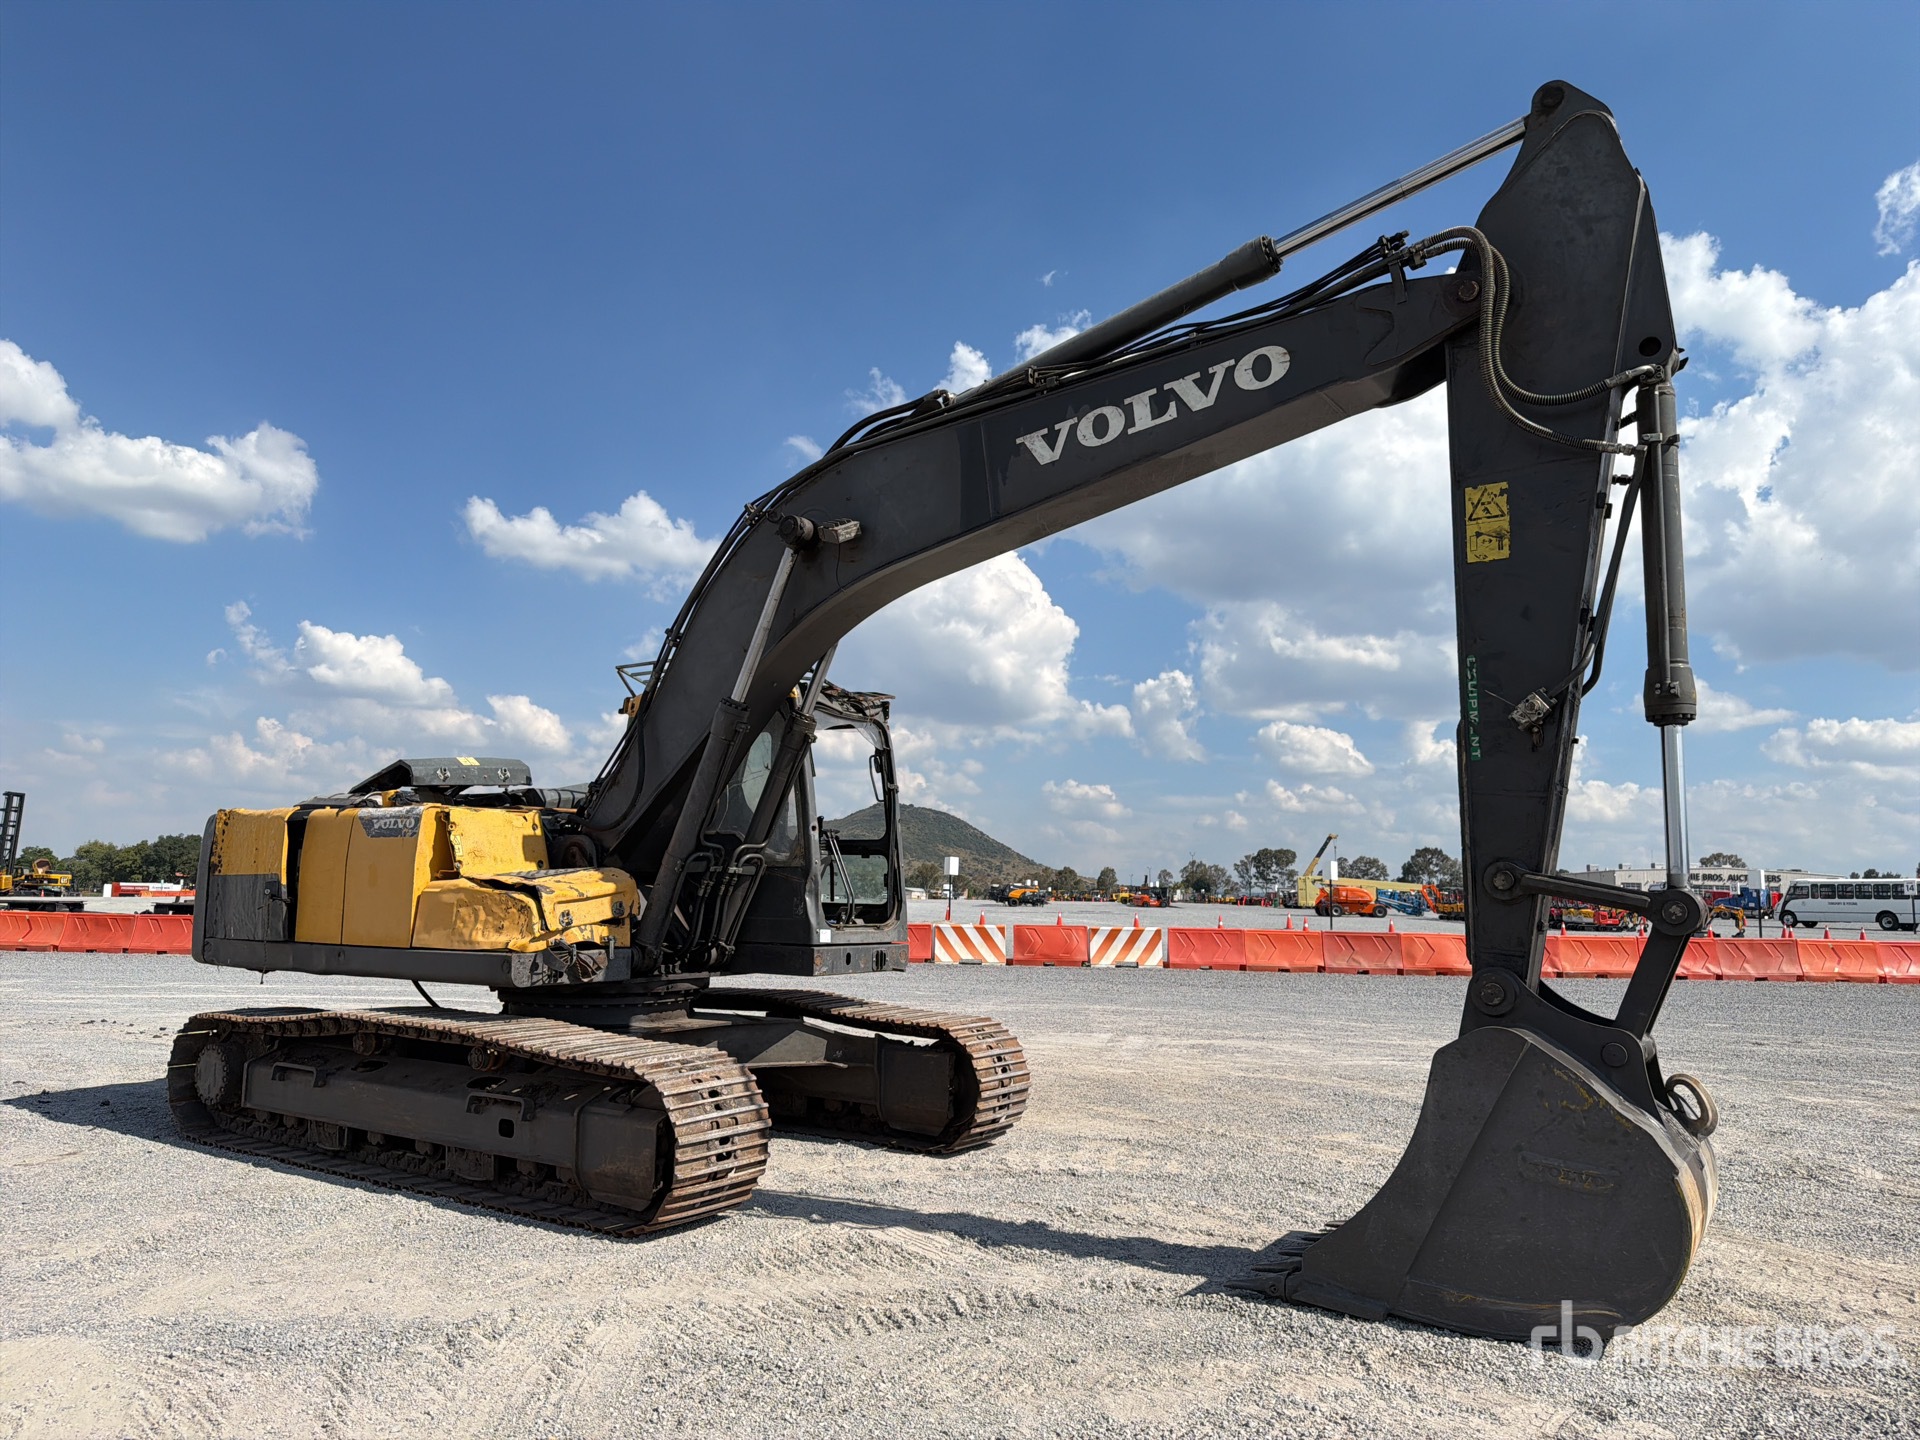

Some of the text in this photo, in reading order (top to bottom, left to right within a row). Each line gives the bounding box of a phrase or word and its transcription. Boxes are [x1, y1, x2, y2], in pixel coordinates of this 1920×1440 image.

[1016, 345, 1290, 466] VOLVO
[372, 818, 415, 829] VOLVO
[1905, 884, 1914, 892] 14
